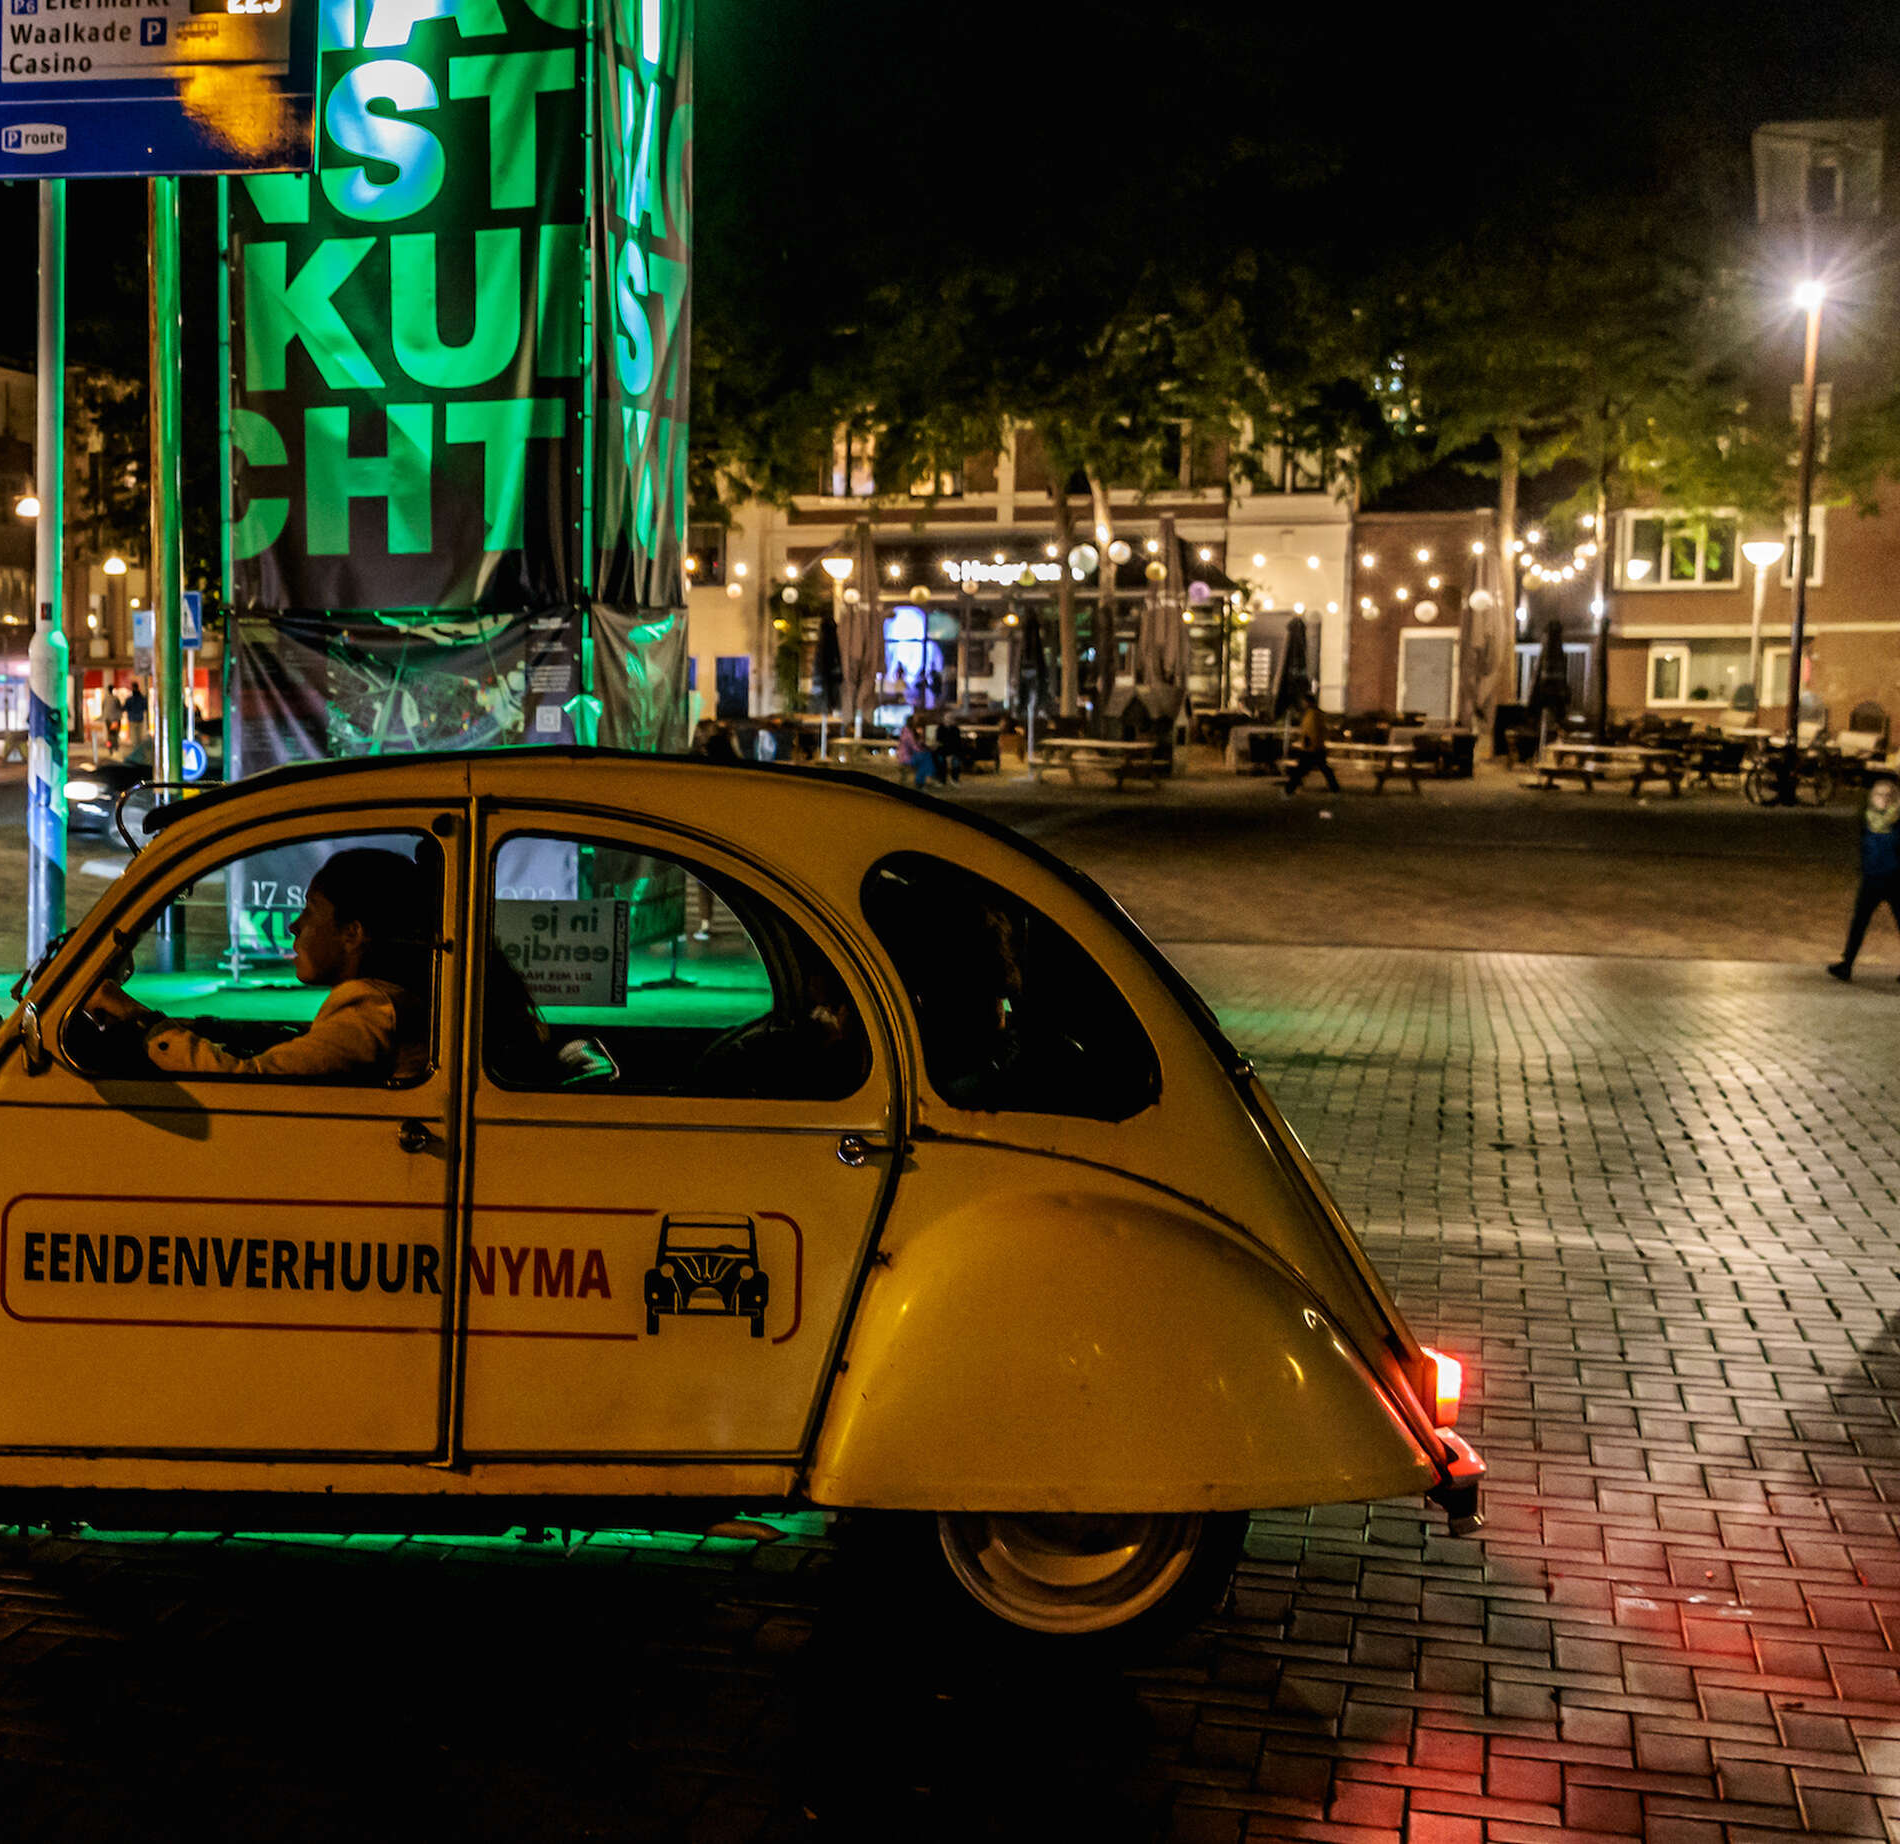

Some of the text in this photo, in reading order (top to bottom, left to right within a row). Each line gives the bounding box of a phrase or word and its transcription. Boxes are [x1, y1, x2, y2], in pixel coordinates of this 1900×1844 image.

[10, 20, 132, 44] Waalkade
[9, 53, 92, 75] Casino
[25, 131, 64, 145] route
[252, 880, 278, 909] 17
[239, 910, 300, 950] KU
[24, 1231, 612, 1300] EENDENVERHUUR NYMA
